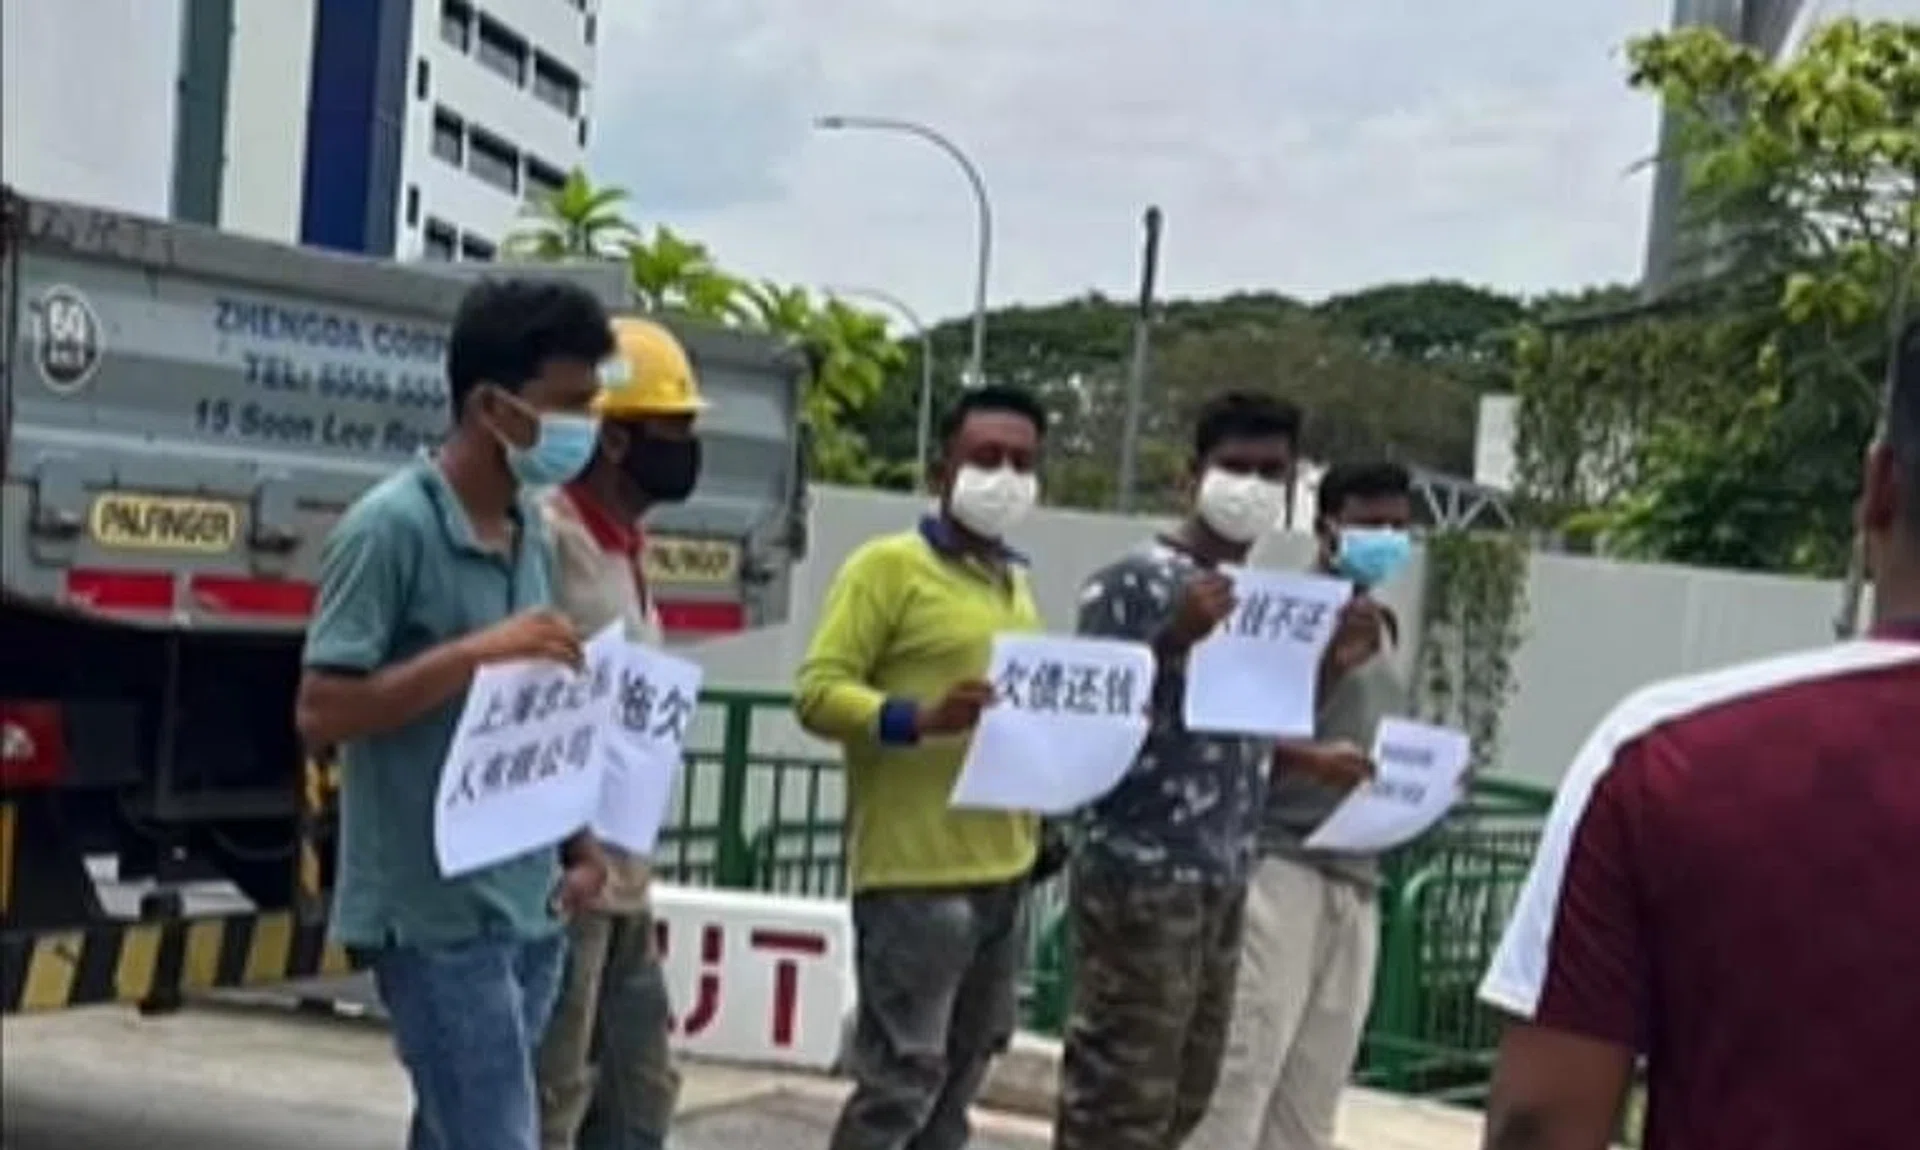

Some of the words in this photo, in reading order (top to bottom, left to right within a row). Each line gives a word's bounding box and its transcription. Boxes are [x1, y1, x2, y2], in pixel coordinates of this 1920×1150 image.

[215, 298, 364, 353] ZHENGDA
[243, 351, 313, 393] TEL:
[195, 399, 231, 434] 15
[240, 401, 315, 441] Soon
[321, 409, 376, 449] Lee
[100, 502, 229, 543] PALFINGER
